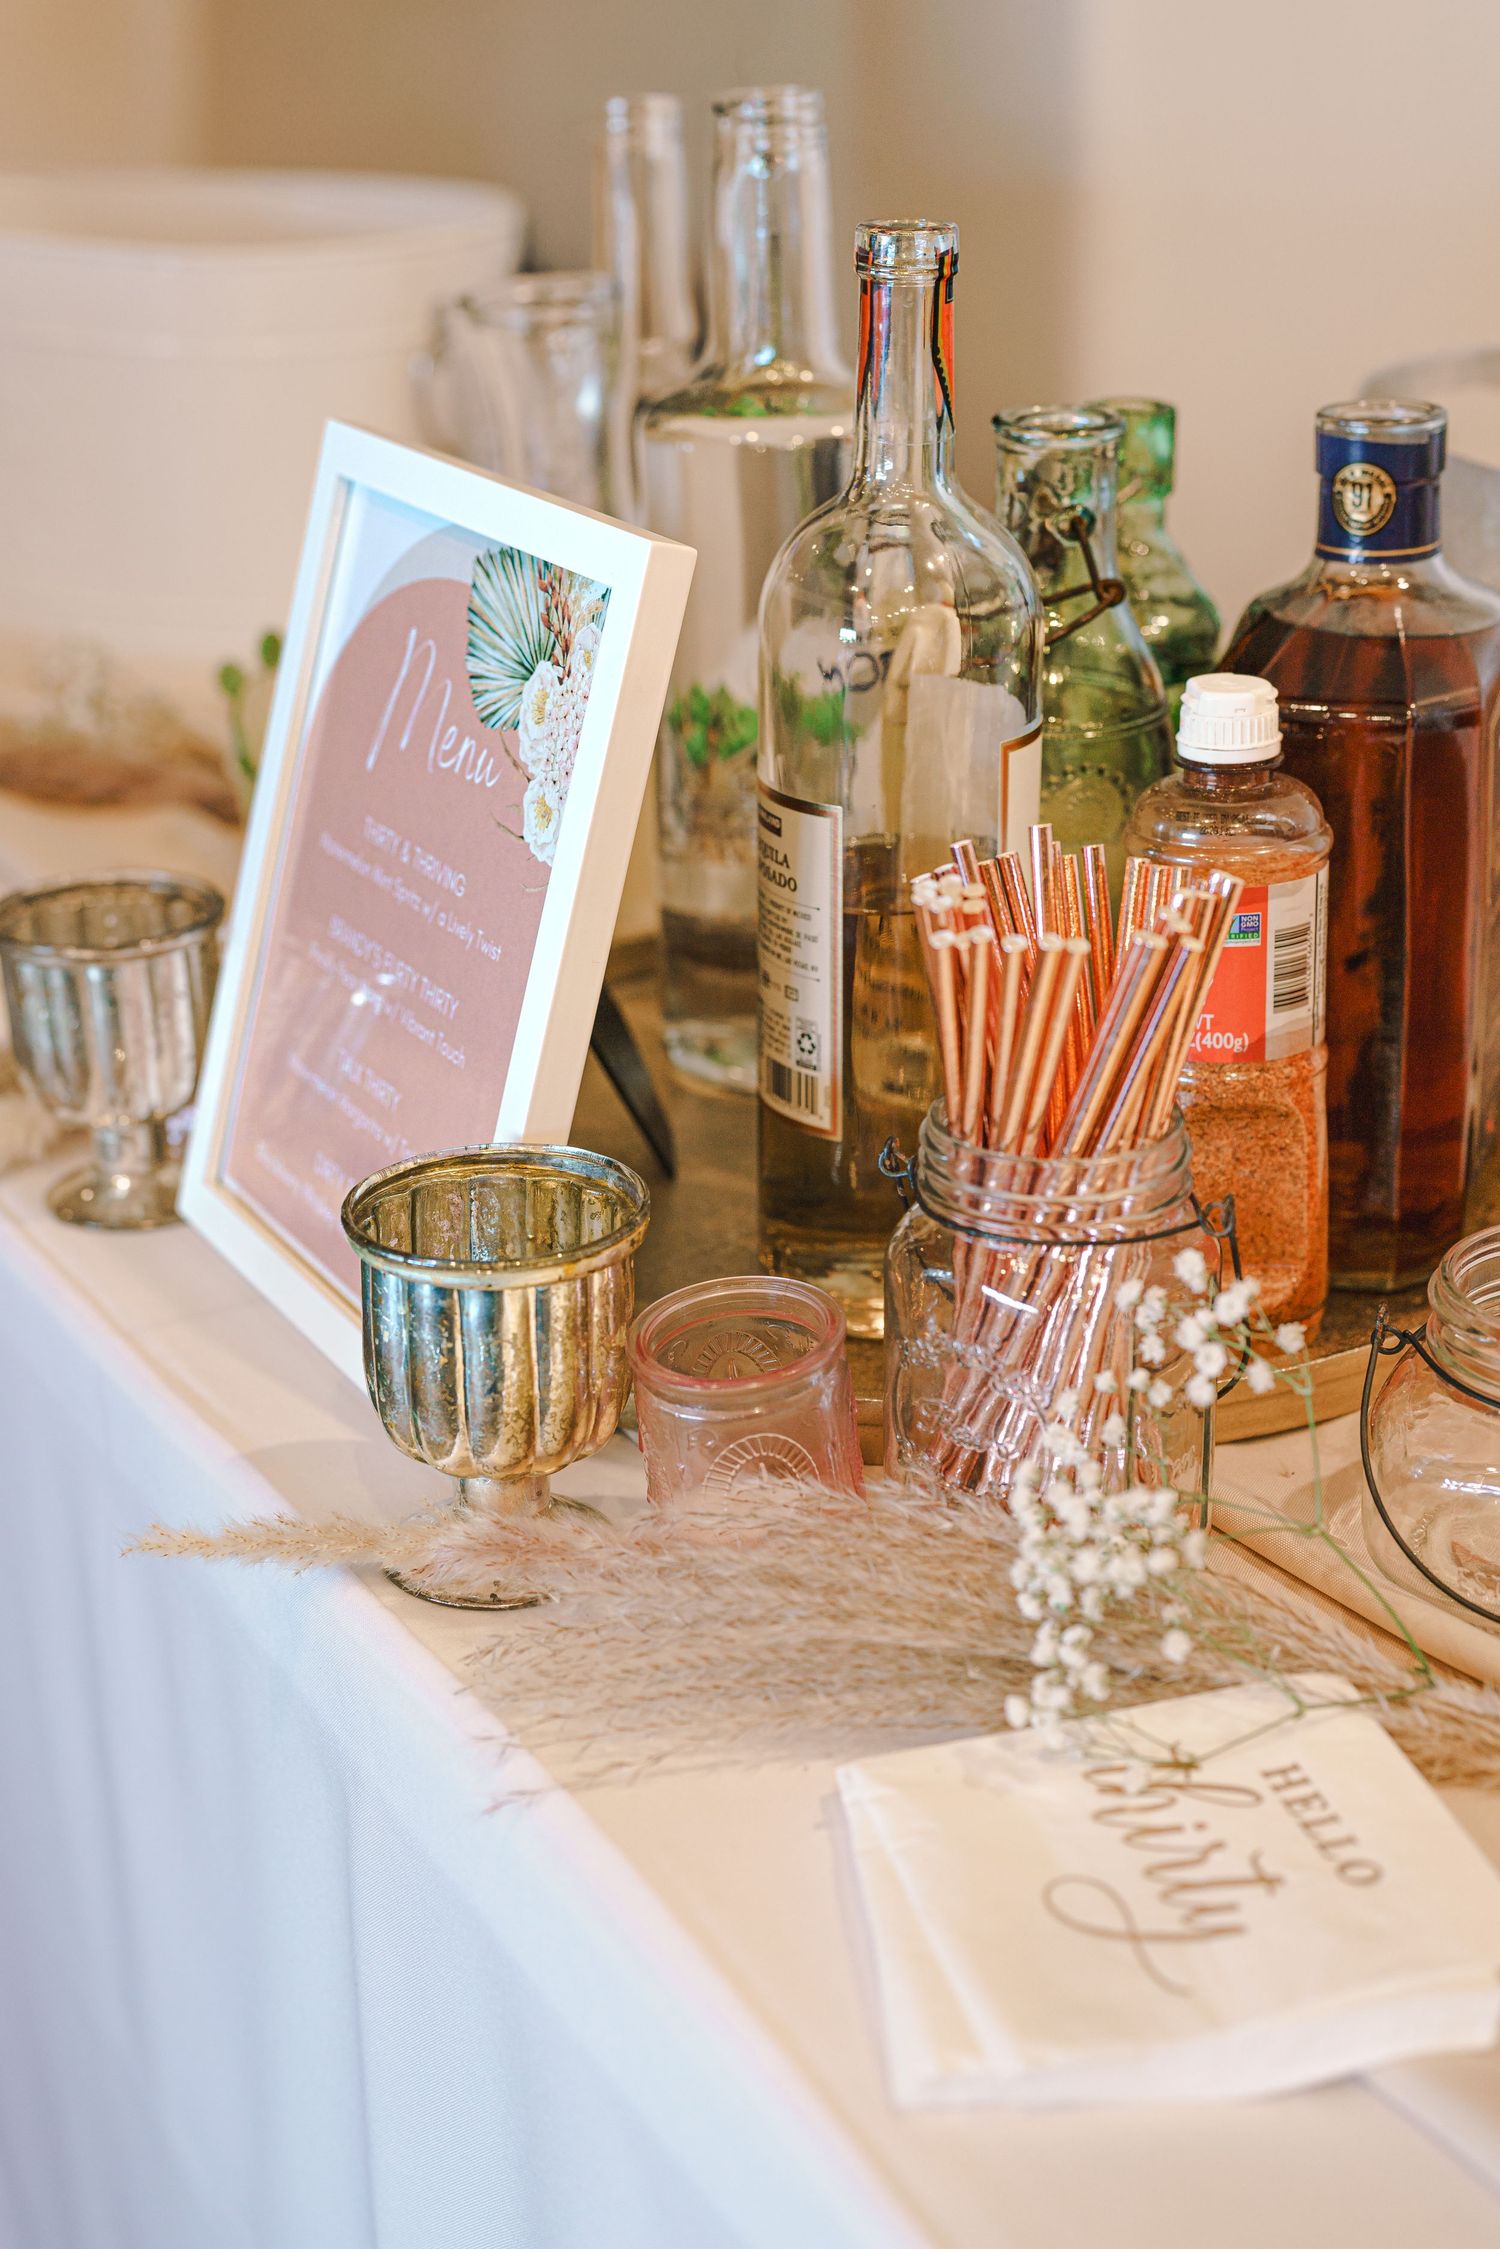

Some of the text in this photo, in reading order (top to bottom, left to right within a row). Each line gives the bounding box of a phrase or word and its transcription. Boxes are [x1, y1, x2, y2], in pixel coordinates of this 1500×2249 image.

[367, 626, 500, 788] Menu
[401, 840, 412, 864] &
[412, 846, 466, 896] THRIVING
[438, 912, 446, 928] a
[447, 911, 473, 950] Lively
[475, 928, 501, 961] Twist
[420, 976, 460, 1019] THIRTY
[436, 1031, 465, 1069] Touch
[1260, 1762, 1385, 1888] HELLO
